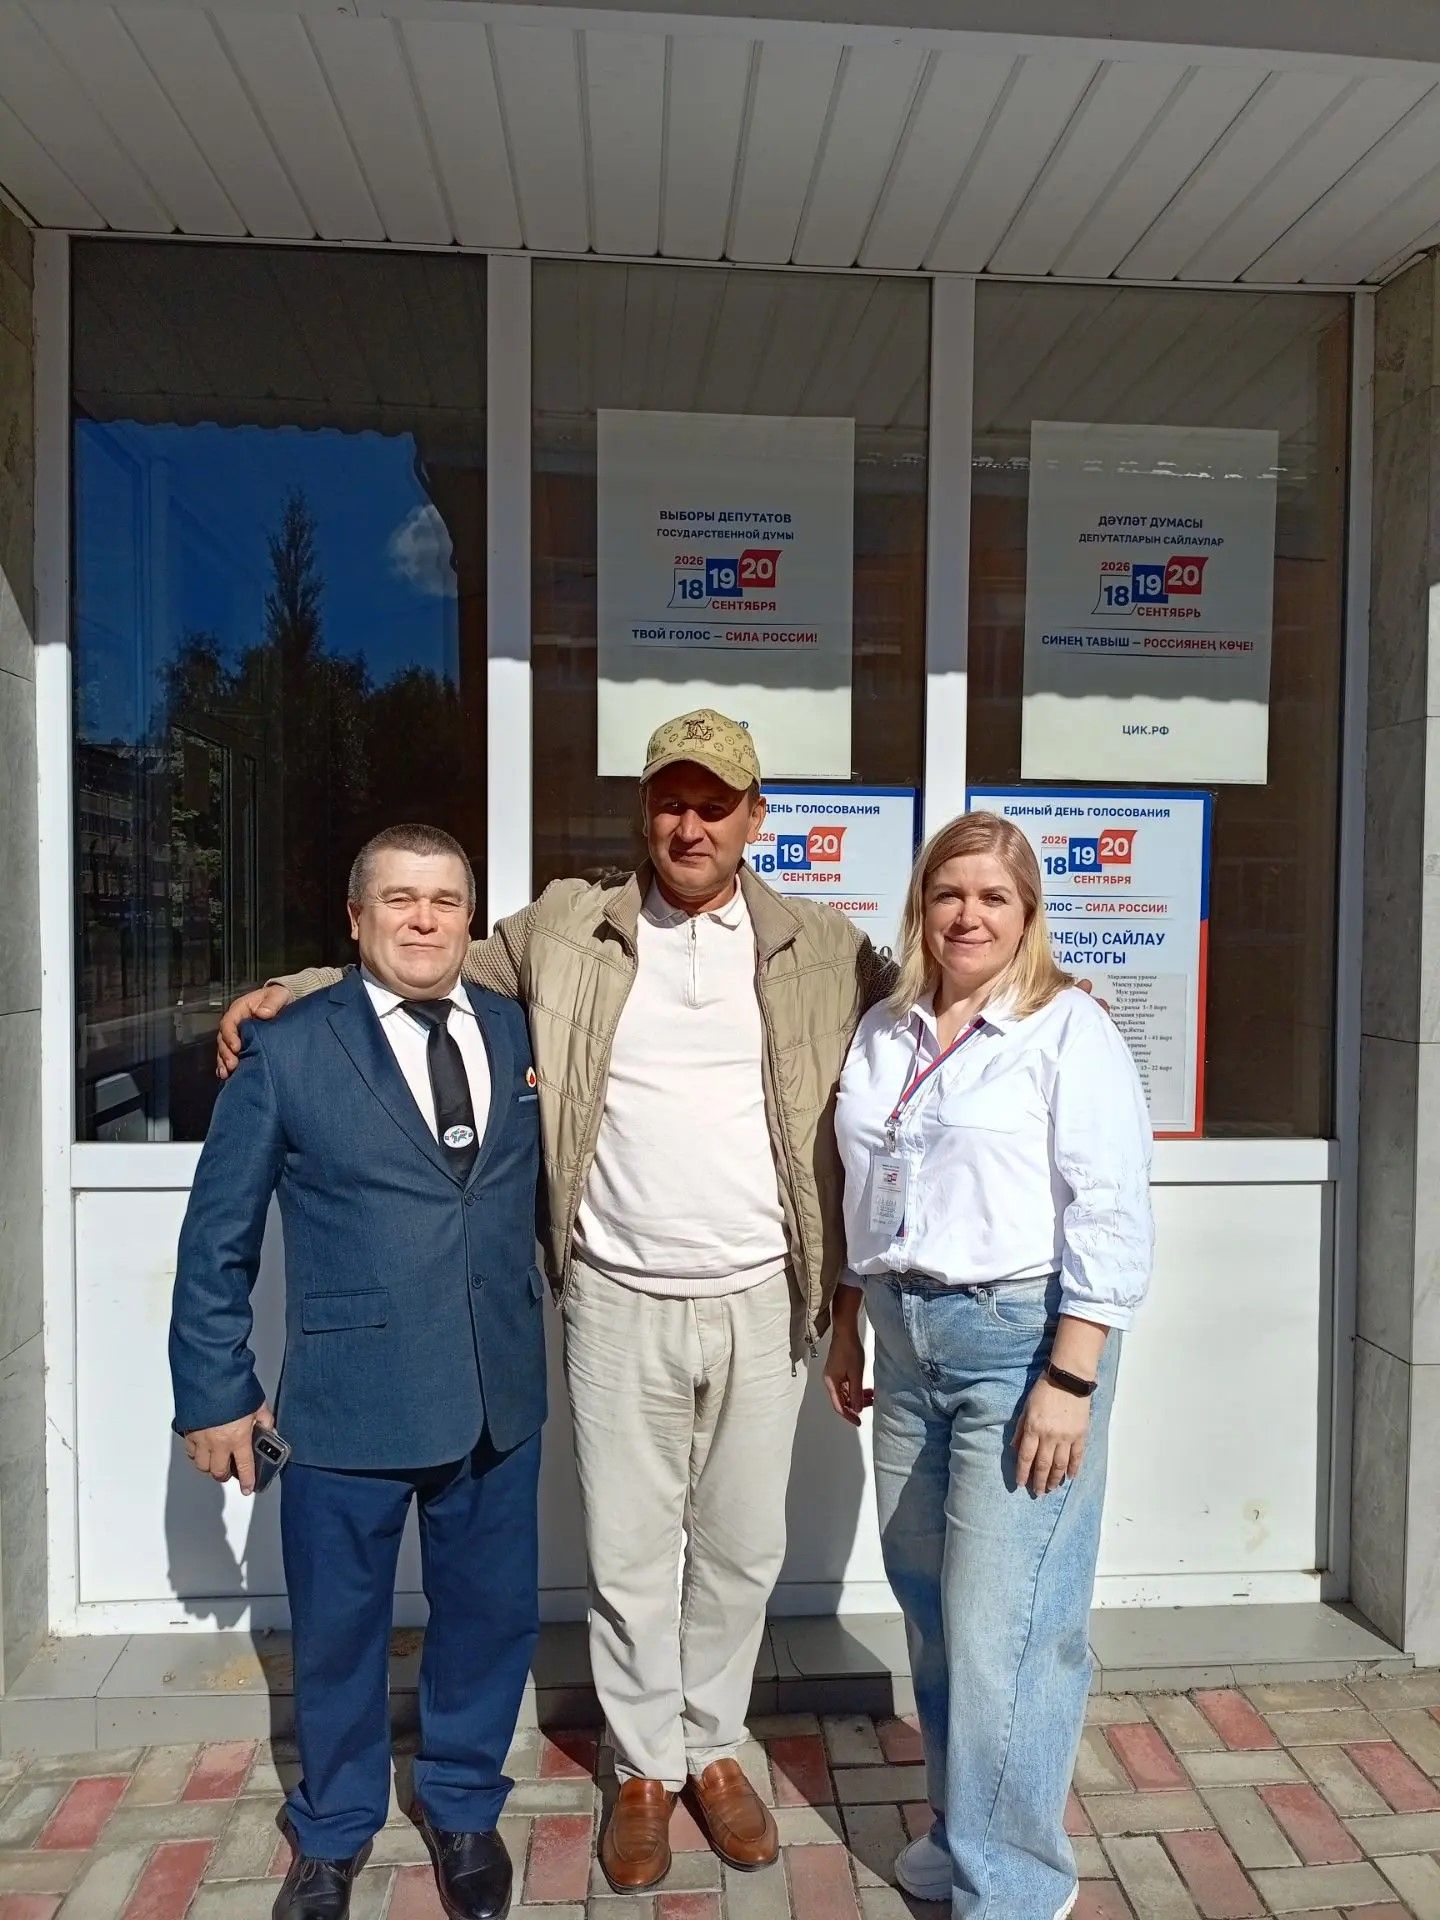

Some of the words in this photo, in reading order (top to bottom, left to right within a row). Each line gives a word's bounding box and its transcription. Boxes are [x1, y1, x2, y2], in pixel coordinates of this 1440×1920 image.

[659, 510, 715, 522] ВЫБОРЫ
[718, 511, 792, 524] ДЕПУТАТОВ
[1098, 515, 1147, 528] ДӘҮЛӘТ
[1150, 517, 1203, 529] ДУМАСЫ
[656, 528, 760, 540] ГОСУДАРСТВЕННОЙ
[762, 530, 794, 541] ДУМЫ
[1078, 533, 1161, 545] ДЕПУТАТЛАРЫН
[1163, 534, 1224, 547] САЙЛАУЛАР
[674, 555, 704, 566] 2026
[1101, 561, 1131, 572] 2026
[678, 579, 704, 600] 18
[709, 568, 735, 589] 19
[741, 558, 773, 579] 20
[1104, 585, 1130, 607] 18
[1136, 575, 1162, 596] 19
[1167, 565, 1199, 586] 20
[711, 600, 776, 612] СЕНТЯБРЯ
[1137, 606, 1201, 618] СЕНТЯБРЬ
[632, 628, 666, 640] ТВОЙ
[669, 630, 711, 641] ГОЛОС
[725, 631, 760, 642] СИЛА
[762, 632, 818, 643] РОССИИ!
[1041, 634, 1083, 647] СИНЕҢ
[1086, 636, 1130, 647] ТАВЫШ
[1143, 638, 1216, 651] РОССИЯНЕҢ
[1219, 640, 1254, 651] КӨЧЕ!
[1122, 725, 1169, 736] ЦИК.РФ
[795, 804, 880, 815] ГОЛОСОВАНИЯ
[1004, 804, 1053, 816] ЕДИНЫЙ
[1054, 807, 1084, 817] ДЕНЬ
[1087, 807, 1170, 818] ГОЛОСОВАНИЯ
[1041, 835, 1067, 844] 2026
[752, 854, 775, 873] 18
[780, 844, 804, 863] 19
[809, 834, 838, 854] 20
[1044, 856, 1067, 875] 18
[1071, 847, 1095, 865] 19
[1101, 837, 1129, 857] 20
[782, 872, 841, 882] СЕНТЯБРЯ
[1073, 875, 1131, 885] СЕНТЯБРЯ
[1085, 903, 1116, 912] СИЛА
[1118, 904, 1168, 913] РОССИИ!
[1102, 930, 1165, 946] САЙЛАУ
[1053, 951, 1126, 964] ЧАСТОГЫ
